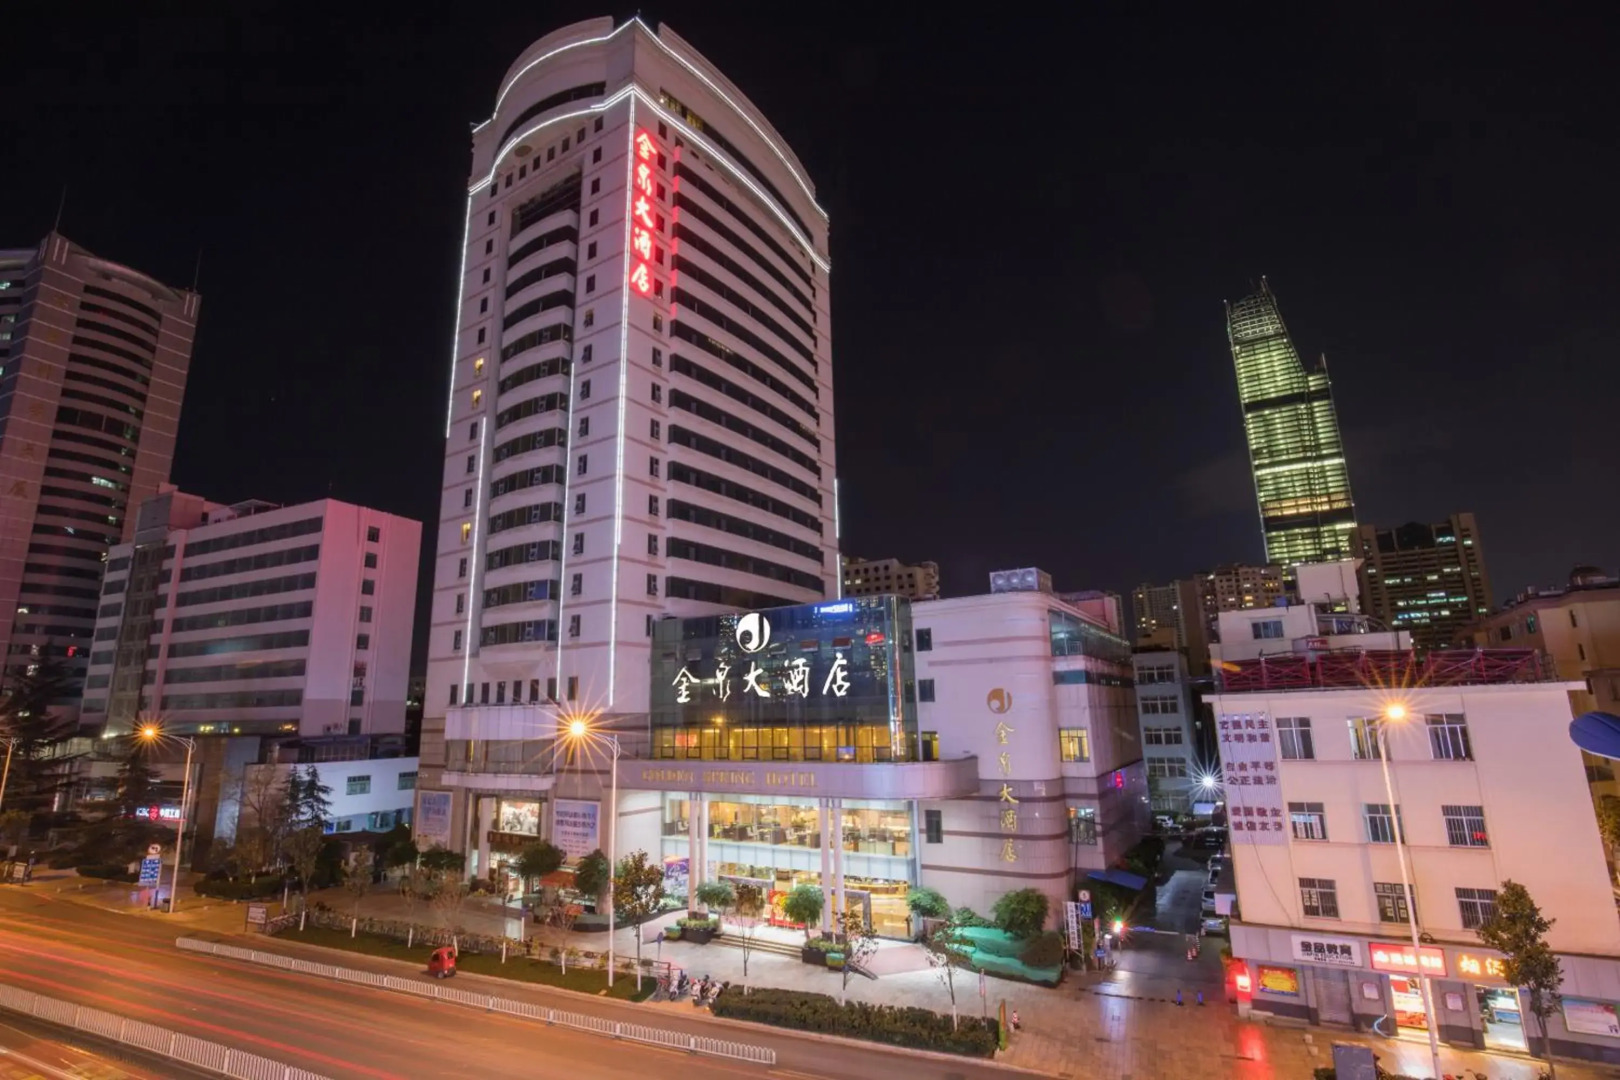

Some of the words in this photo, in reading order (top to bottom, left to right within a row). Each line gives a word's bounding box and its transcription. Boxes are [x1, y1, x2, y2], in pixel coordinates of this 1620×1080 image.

[631, 133, 656, 292] 金泉大酒店
[672, 653, 851, 703] 金泉大酒店
[995, 721, 1019, 862] 金泉大酒店
